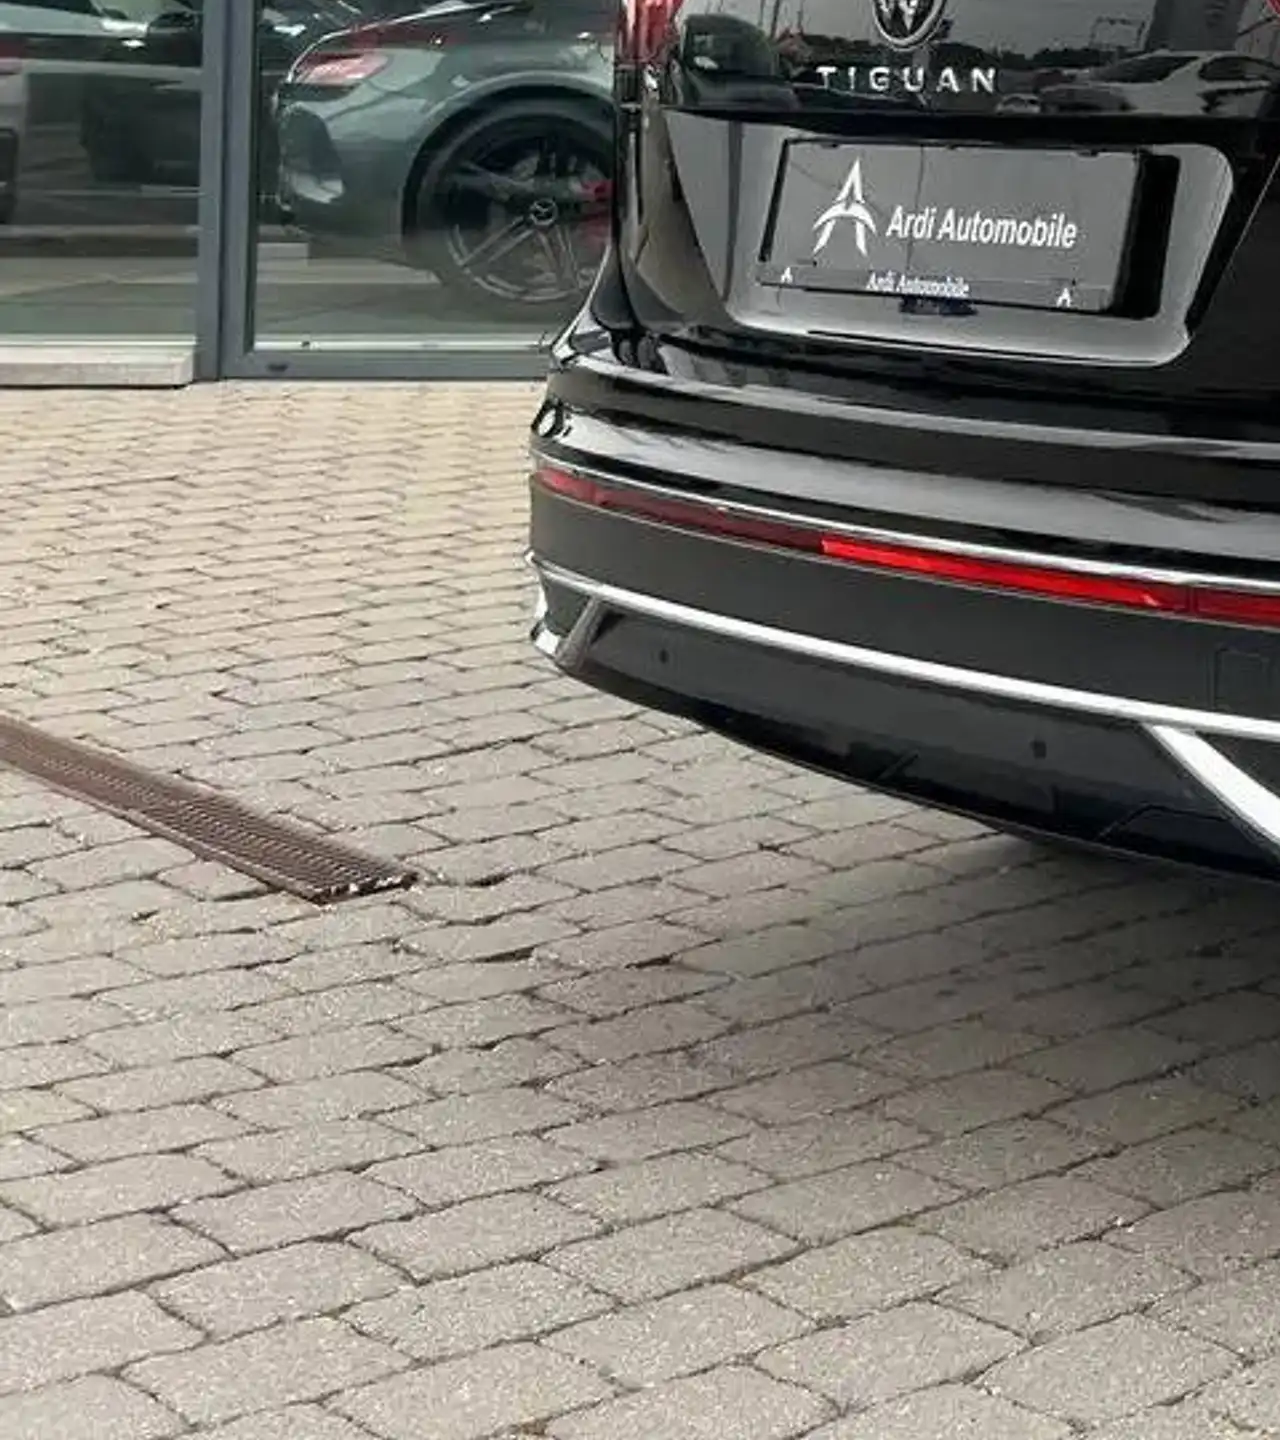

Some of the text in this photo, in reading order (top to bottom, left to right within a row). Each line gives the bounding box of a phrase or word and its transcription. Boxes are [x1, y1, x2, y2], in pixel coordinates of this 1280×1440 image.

[815, 65, 997, 93] TIGUAN
[885, 205, 1079, 249] Ardi Automobile
[865, 269, 971, 298] Ardi Automobile
